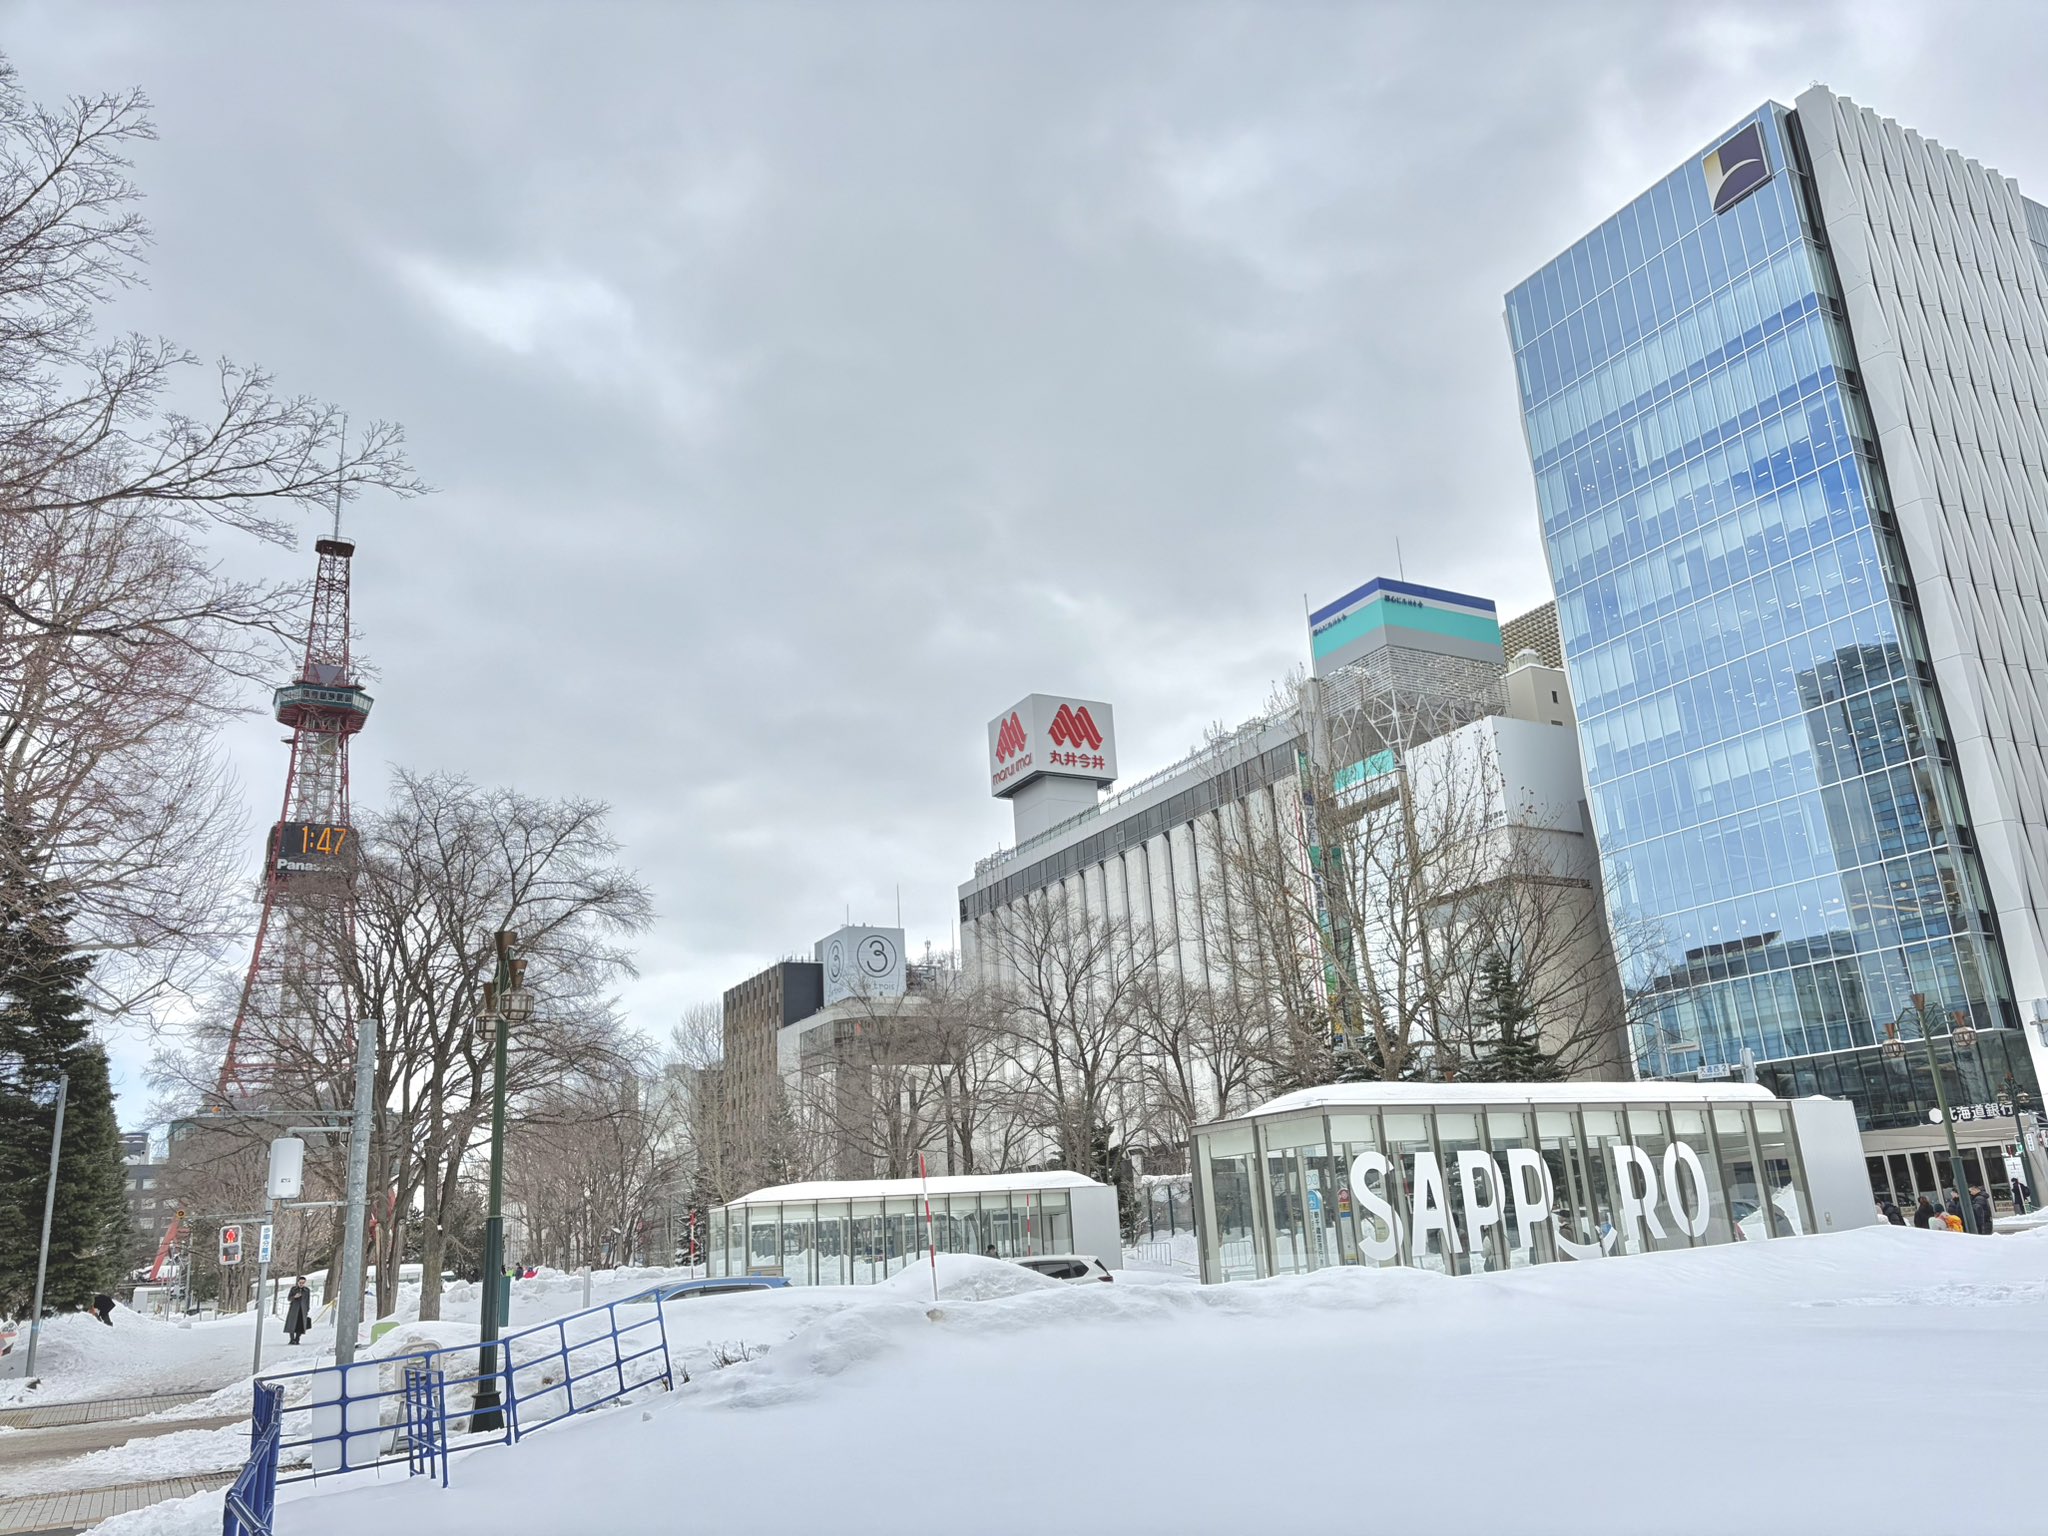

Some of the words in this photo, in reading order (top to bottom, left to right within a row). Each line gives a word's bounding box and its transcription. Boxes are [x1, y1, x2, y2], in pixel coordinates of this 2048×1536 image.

[1050, 750, 1105, 770] 丸井今井
[302, 826, 347, 855] 1:47
[277, 859, 347, 873] Panas
